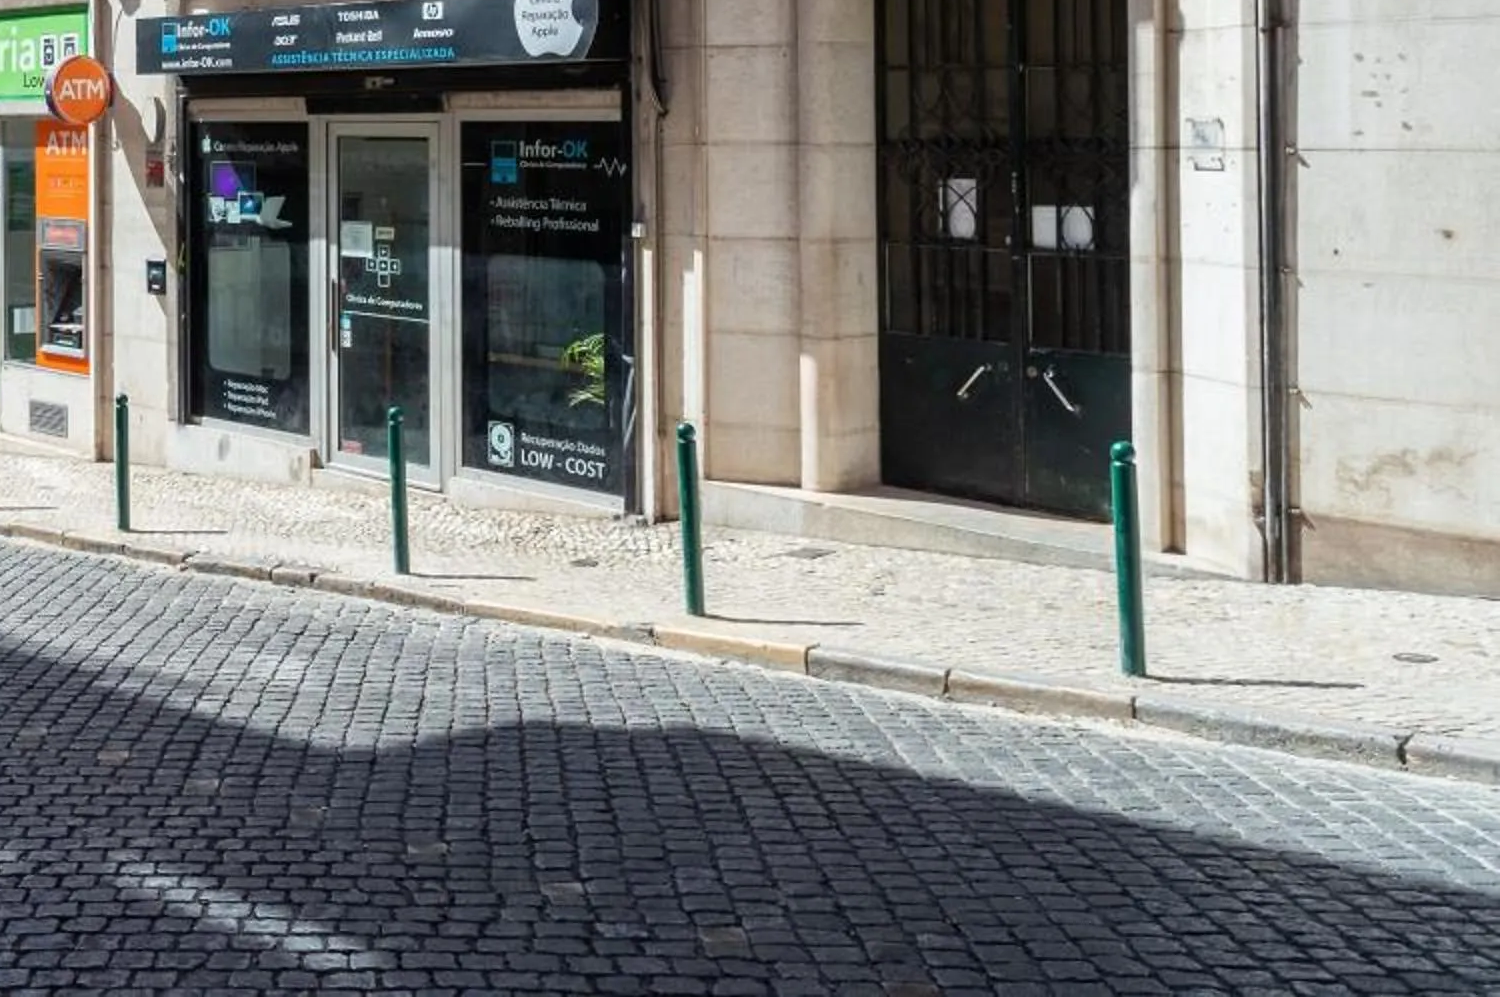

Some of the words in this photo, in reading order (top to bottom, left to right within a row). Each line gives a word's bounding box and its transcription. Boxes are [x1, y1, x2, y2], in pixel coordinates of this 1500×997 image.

[271, 14, 300, 27] ASUS
[337, 10, 380, 22] TOSHIBA
[177, 18, 231, 38] Infor-OK
[375, 47, 455, 61] ESPECIALIZADA
[59, 78, 106, 101] ATM
[46, 130, 88, 156] ATM
[520, 139, 588, 158] Infor-OK
[542, 216, 600, 232] Profissional
[521, 449, 554, 470] LOW
[565, 457, 606, 480] COST
